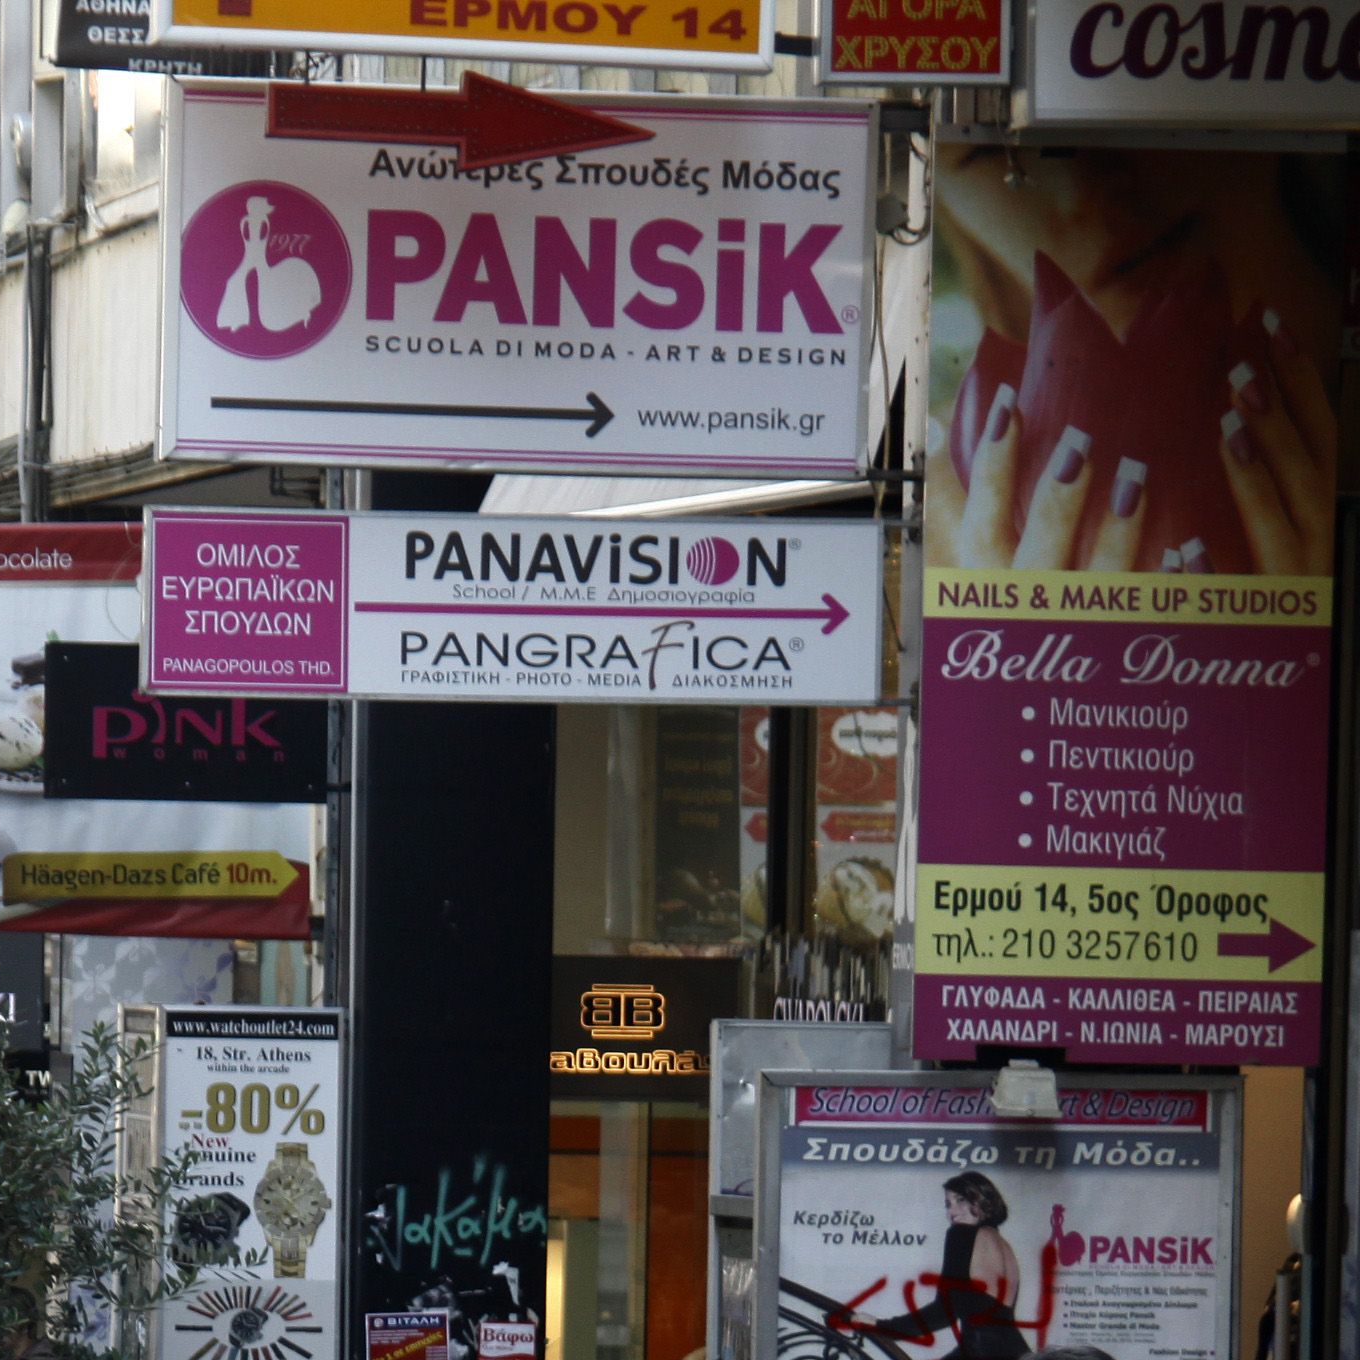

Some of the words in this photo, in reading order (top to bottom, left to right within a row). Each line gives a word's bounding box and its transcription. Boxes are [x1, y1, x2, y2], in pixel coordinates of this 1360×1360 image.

[408, 0, 645, 37] ΕΡΜΟΥ
[671, 7, 747, 40] 14
[834, 34, 997, 72] ΧΡΥΣΟΥ
[555, 153, 710, 197] Σπουδές
[723, 159, 841, 199] Μόδας
[364, 334, 488, 360] SCUOLA
[495, 339, 525, 360] DI
[532, 340, 615, 363] MODA
[645, 344, 701, 366] ART
[737, 346, 847, 368] DESIGN
[637, 405, 825, 437] www.pansik.gr
[196, 542, 301, 569] ΟΜΙΛΟΣ
[162, 574, 334, 603] ΕΥΡΩΠΑΪΚΩΝ
[452, 583, 519, 600] School
[938, 581, 1019, 609] NAILS
[1061, 584, 1141, 612] MAKE
[1152, 587, 1188, 613] UP
[1198, 588, 1318, 616] STUDIOS
[184, 609, 312, 638] ΣΠΟΥΔΩΝ
[162, 657, 295, 677] PANAGOPOULOS
[941, 629, 1101, 683] Bella
[1120, 634, 1308, 688] Donna
[400, 669, 501, 687] ΓΡΑΦΙΣΤΙΚΗ
[517, 671, 572, 686] PHOTO
[587, 672, 641, 687] MEDIA
[672, 673, 793, 689] ΔΙΑΚΟΣΜΗΣΗ
[1049, 698, 1189, 731] Μανικιούρ
[1048, 740, 1195, 777] Πεντικιούρ
[1047, 782, 1158, 817] Τεχνητά
[1167, 785, 1245, 821] Νύχια
[1046, 824, 1167, 861] Μακιγιάζ
[21, 863, 167, 889] Häagen-Dazs
[171, 861, 220, 887] Café
[226, 863, 277, 887] 10m.
[935, 880, 1022, 918] Ερμού
[1036, 884, 1076, 917] 14,
[1088, 884, 1140, 920] 5ος
[1150, 883, 1269, 923] Όροφος
[1002, 928, 1056, 960] 210
[1067, 930, 1199, 962] 3257610
[941, 984, 1046, 1010] ΓΛΥΦΑΔΑ
[1068, 986, 1176, 1013] ΚΑΛΛΙΘΕΑ
[1198, 989, 1299, 1015] ΠΕΙΡΑΙΑΣ
[173, 1018, 335, 1036] www.watchoutlet24.com
[946, 1018, 1058, 1043] ΧΑΛΑΝΔΡΙ
[1080, 1020, 1163, 1045] Ν.ΙΩΝΙΑ
[1185, 1022, 1284, 1048] ΜΑΡΟΥΣΙ
[257, 1048, 312, 1062] Athens
[809, 1087, 895, 1114] School
[902, 1087, 930, 1114] of
[1108, 1091, 1194, 1125] Design
[192, 1134, 229, 1149] New
[802, 1136, 999, 1169] Σπουδάζω
[1014, 1146, 1057, 1170] τη
[793, 1209, 874, 1228] Κερδίζω
[822, 1232, 844, 1245] το
[851, 1229, 927, 1246] Μέλλον
[482, 1328, 534, 1345] Βάφω
